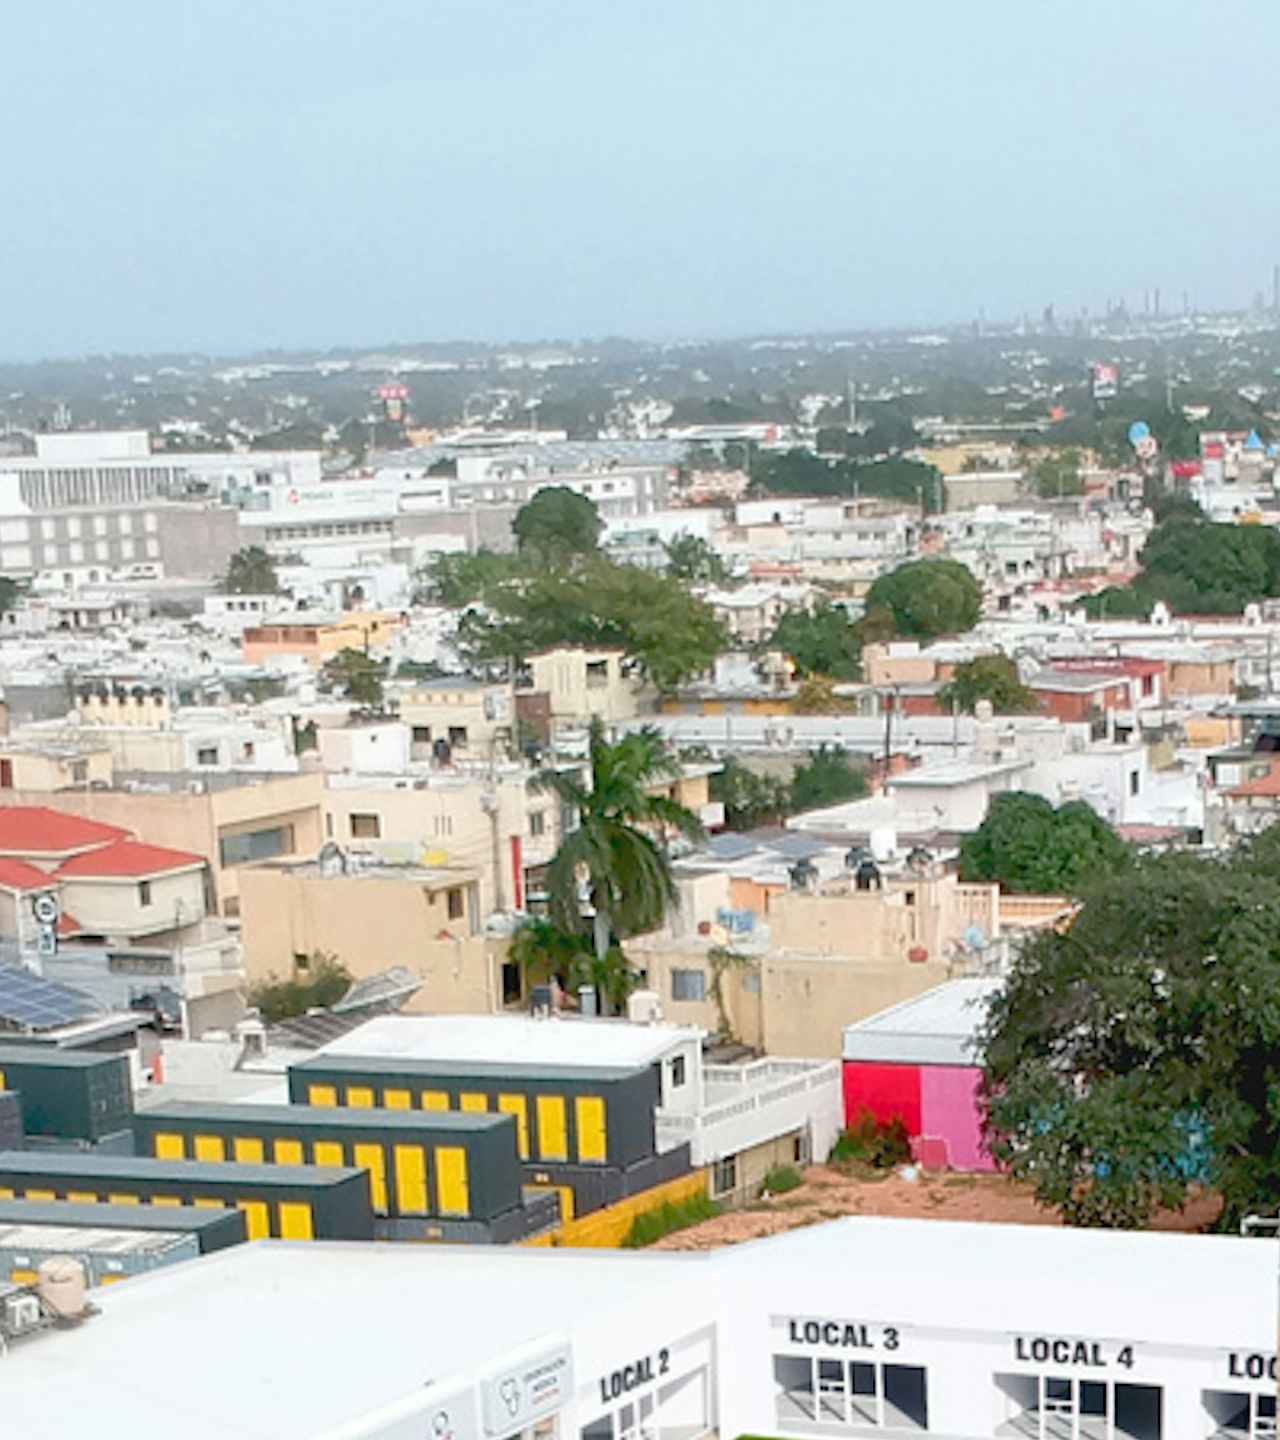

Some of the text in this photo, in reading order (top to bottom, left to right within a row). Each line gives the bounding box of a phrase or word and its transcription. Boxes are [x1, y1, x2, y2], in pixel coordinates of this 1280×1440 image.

[789, 1319, 900, 1350] LOCAL 3
[1015, 1336, 1135, 1369] LOCAL 4
[600, 1355, 655, 1404] LOCAL
[658, 1347, 670, 1376] 2
